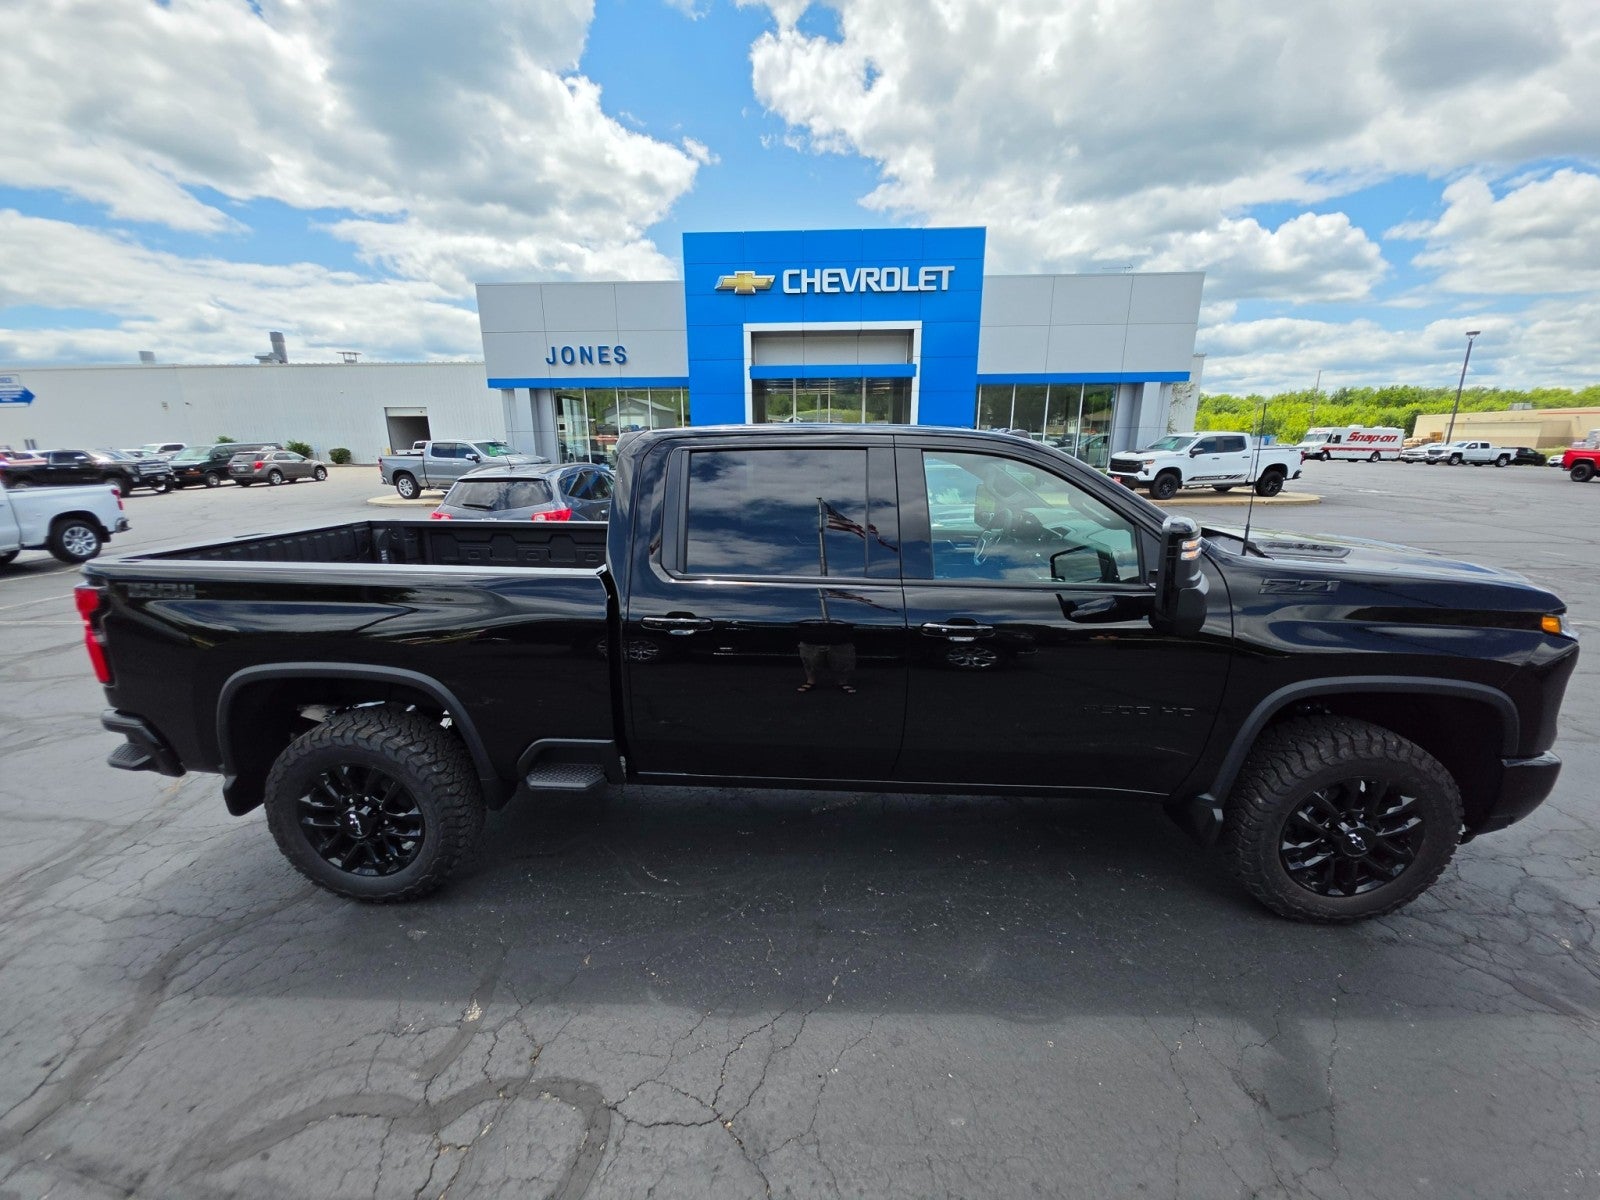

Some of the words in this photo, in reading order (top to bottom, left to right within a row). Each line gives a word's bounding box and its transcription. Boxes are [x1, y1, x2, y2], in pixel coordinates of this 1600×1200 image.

[783, 265, 955, 294] CHEVROLET
[545, 345, 628, 365] JONES
[1346, 431, 1399, 445] Snap-on
